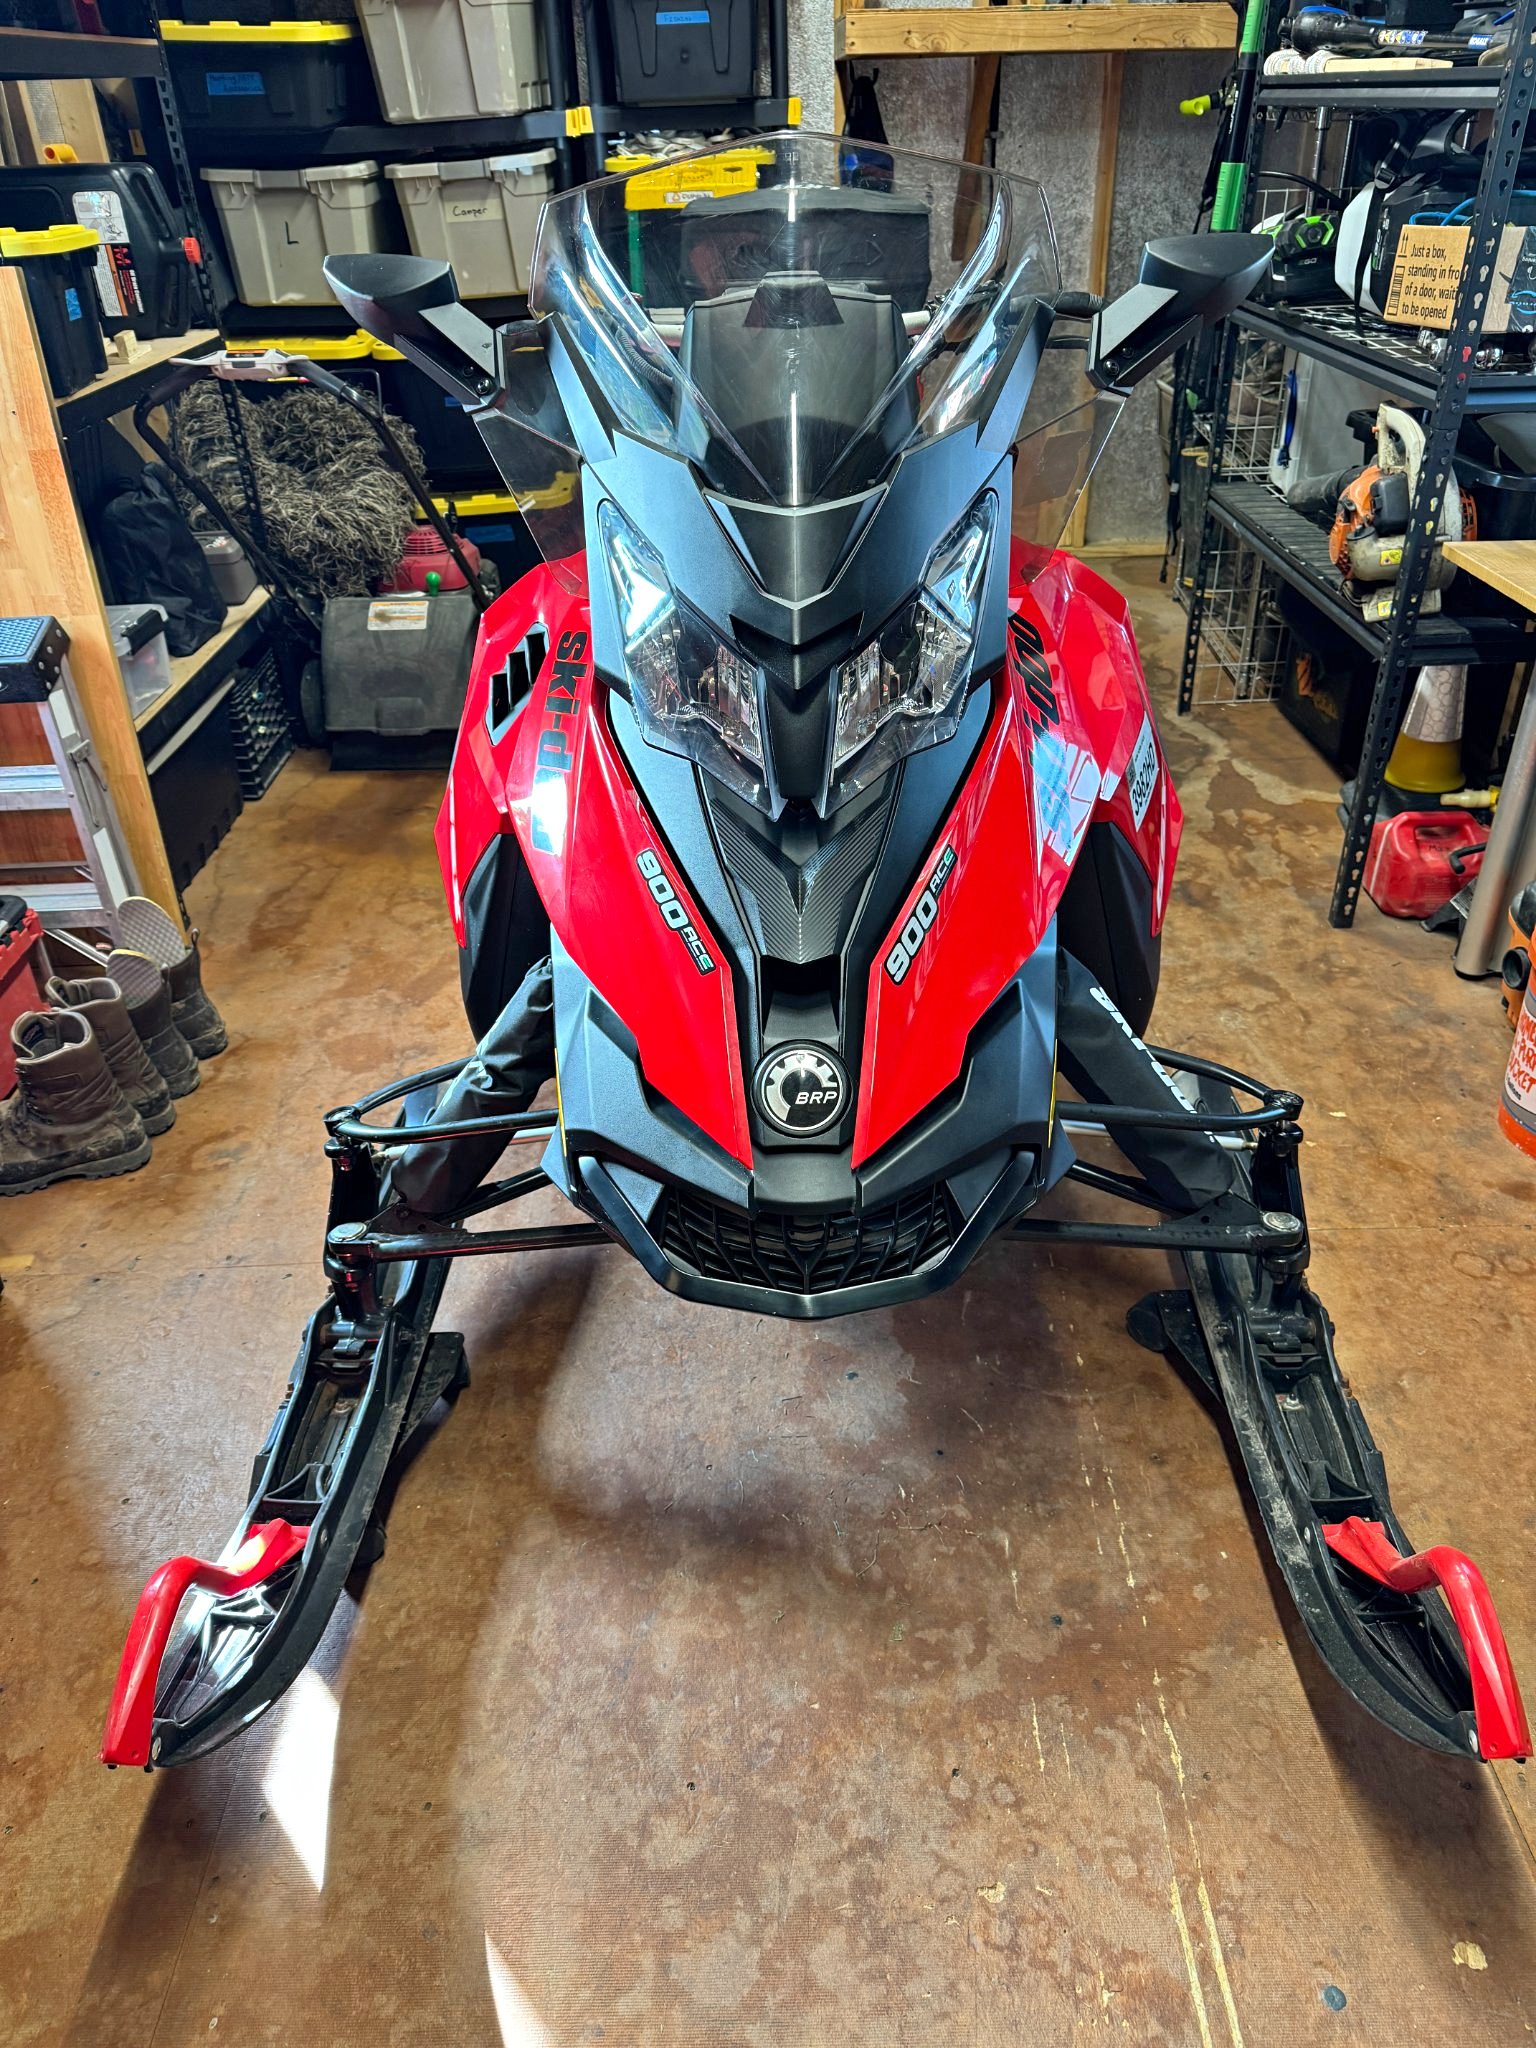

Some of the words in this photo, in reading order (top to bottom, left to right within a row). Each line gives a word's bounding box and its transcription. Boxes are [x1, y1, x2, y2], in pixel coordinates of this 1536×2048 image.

[452, 206, 488, 217] Camper
[285, 221, 299, 245] L
[1411, 244, 1424, 258] Just
[1426, 247, 1430, 258] a
[1432, 245, 1447, 261] box,
[1408, 264, 1437, 280] standing
[1439, 266, 1446, 279] in
[1448, 265, 1459, 280] fro
[1405, 282, 1412, 295] of
[1413, 285, 1417, 296] a
[1419, 284, 1437, 301] door,
[1402, 304, 1409, 314] to
[1410, 304, 1418, 315] be
[1420, 306, 1448, 320] opened
[637, 850, 689, 929] 900
[684, 927, 714, 970] ACE
[887, 890, 937, 983] 900
[930, 847, 954, 893] ACE
[795, 1092, 838, 1104] BRP
